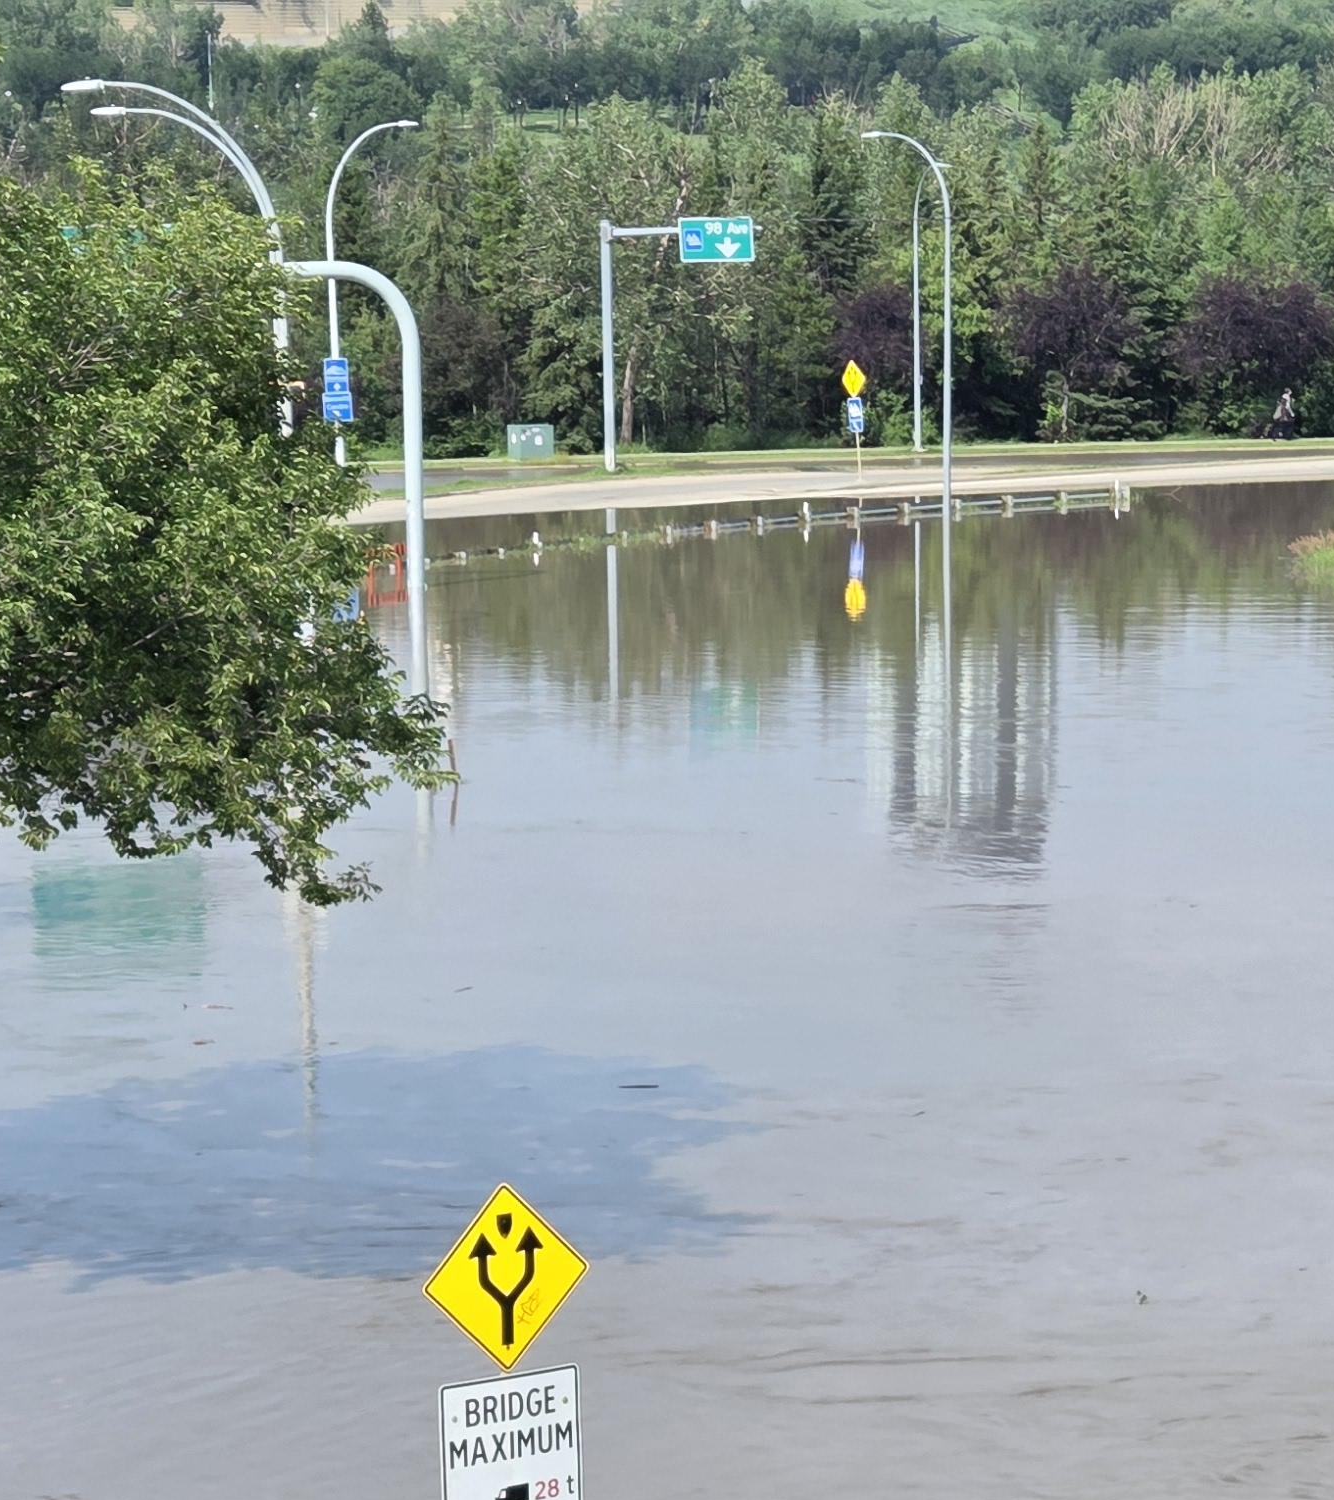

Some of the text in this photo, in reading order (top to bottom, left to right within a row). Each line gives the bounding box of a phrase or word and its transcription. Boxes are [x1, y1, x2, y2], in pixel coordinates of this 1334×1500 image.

[704, 222, 749, 235] 98 Ave
[465, 1385, 556, 1428] BRIDGE
[449, 1420, 574, 1469] MAXIMUM
[535, 1475, 575, 1500] 28 t
